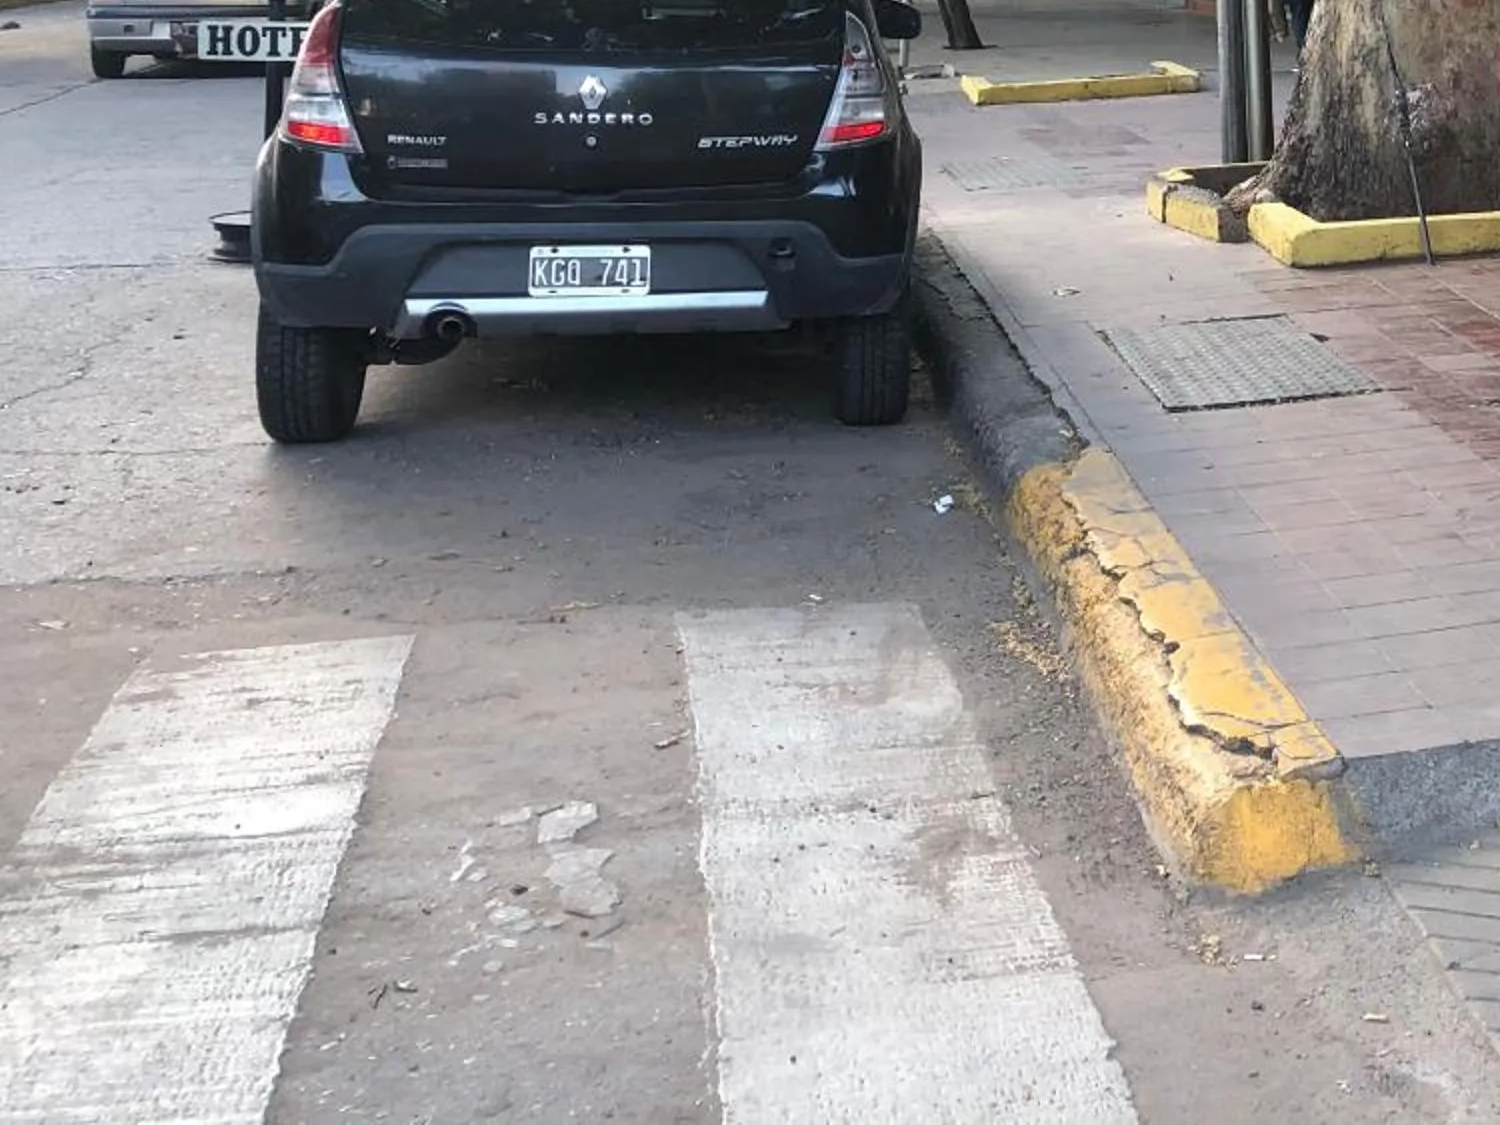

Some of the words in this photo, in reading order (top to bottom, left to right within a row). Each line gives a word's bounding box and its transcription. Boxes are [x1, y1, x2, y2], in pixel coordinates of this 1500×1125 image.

[206, 24, 309, 57] HOTE
[534, 112, 654, 125] SANDERO
[387, 134, 447, 146] RENAULT
[697, 134, 798, 148] STEPWAY
[599, 258, 646, 287] 741
